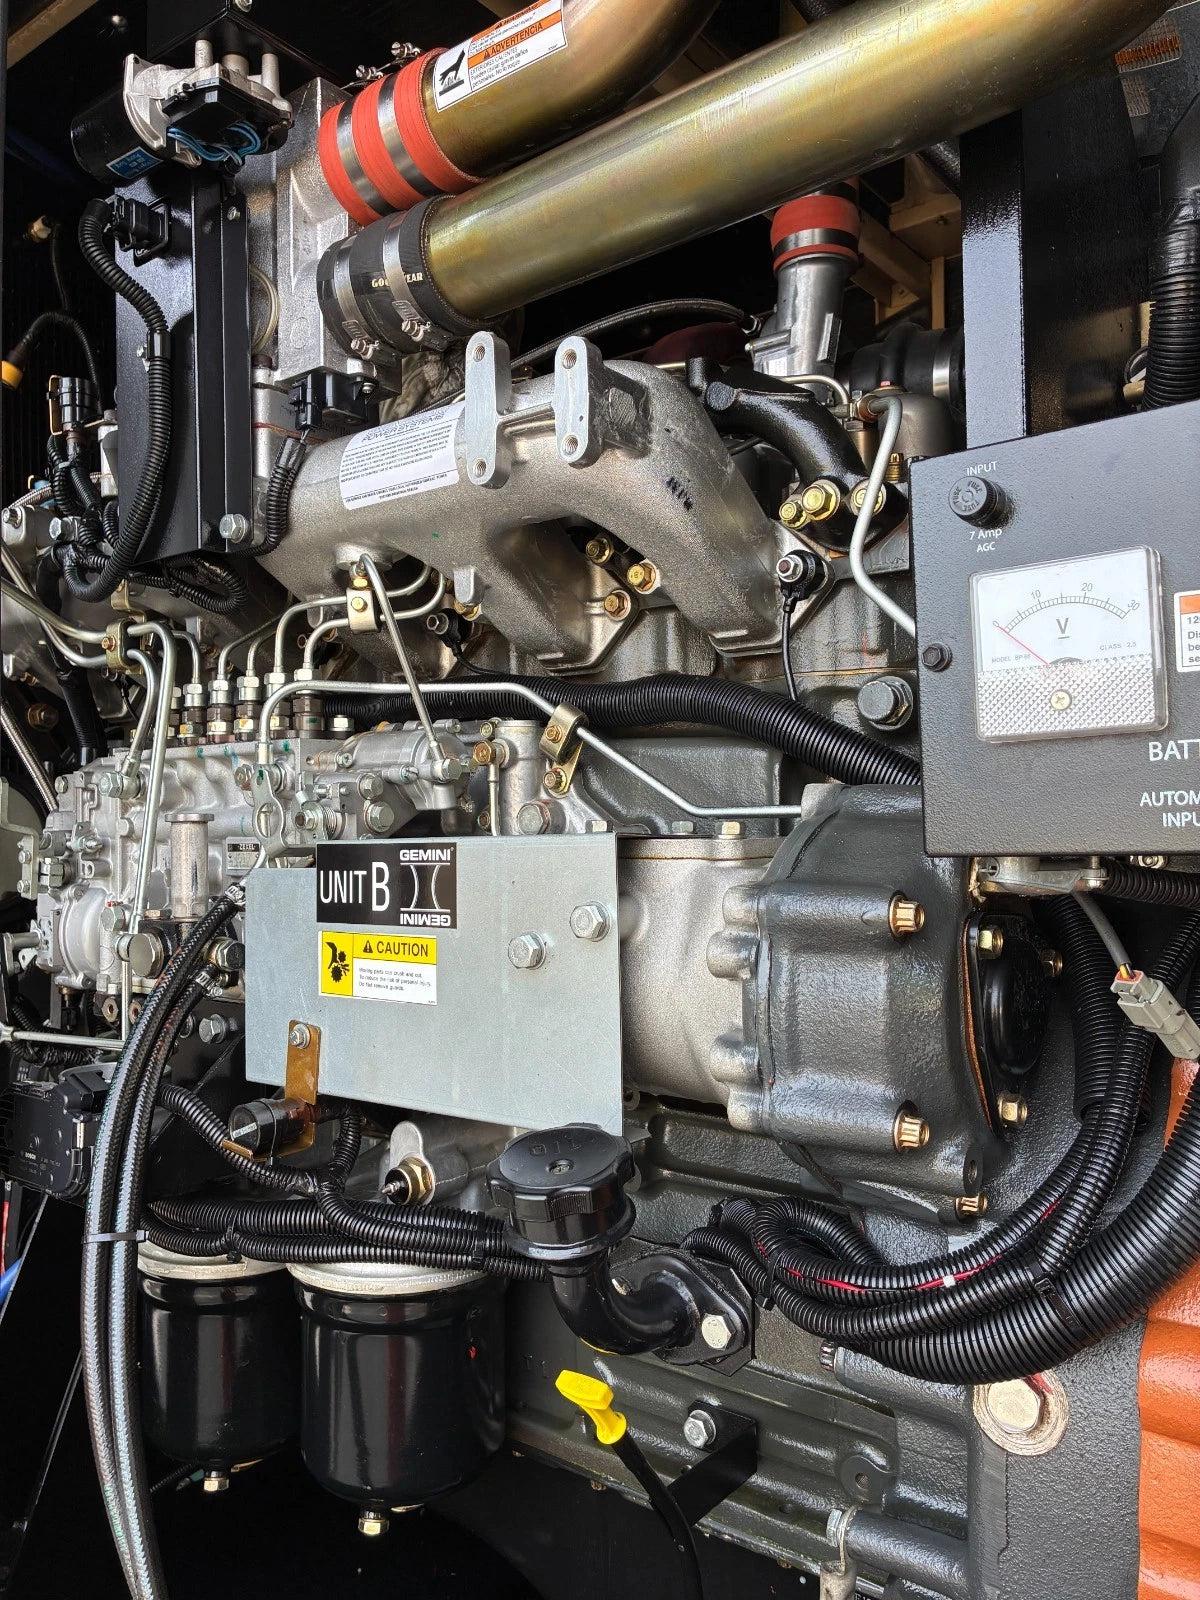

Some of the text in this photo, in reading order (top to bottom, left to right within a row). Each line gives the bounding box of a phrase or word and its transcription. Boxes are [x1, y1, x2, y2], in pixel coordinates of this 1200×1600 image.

[491, 22, 543, 55] ADVERTENCIA
[966, 460, 998, 476] INPUT
[969, 528, 1003, 540] 7 Amp
[976, 541, 996, 553] AGC
[1081, 582, 1093, 593] 20
[1030, 589, 1042, 600] 10
[1127, 599, 1140, 612] 30
[992, 620, 1000, 628] 0
[1056, 617, 1070, 635] V
[1187, 630, 1200, 640] Di
[1099, 642, 1122, 651] CLASS
[991, 655, 1012, 664] MODEL
[399, 848, 451, 861] GEMINI
[319, 861, 390, 912] UNIT B
[399, 913, 451, 927] GEMINI
[376, 940, 429, 958] CAUTION
